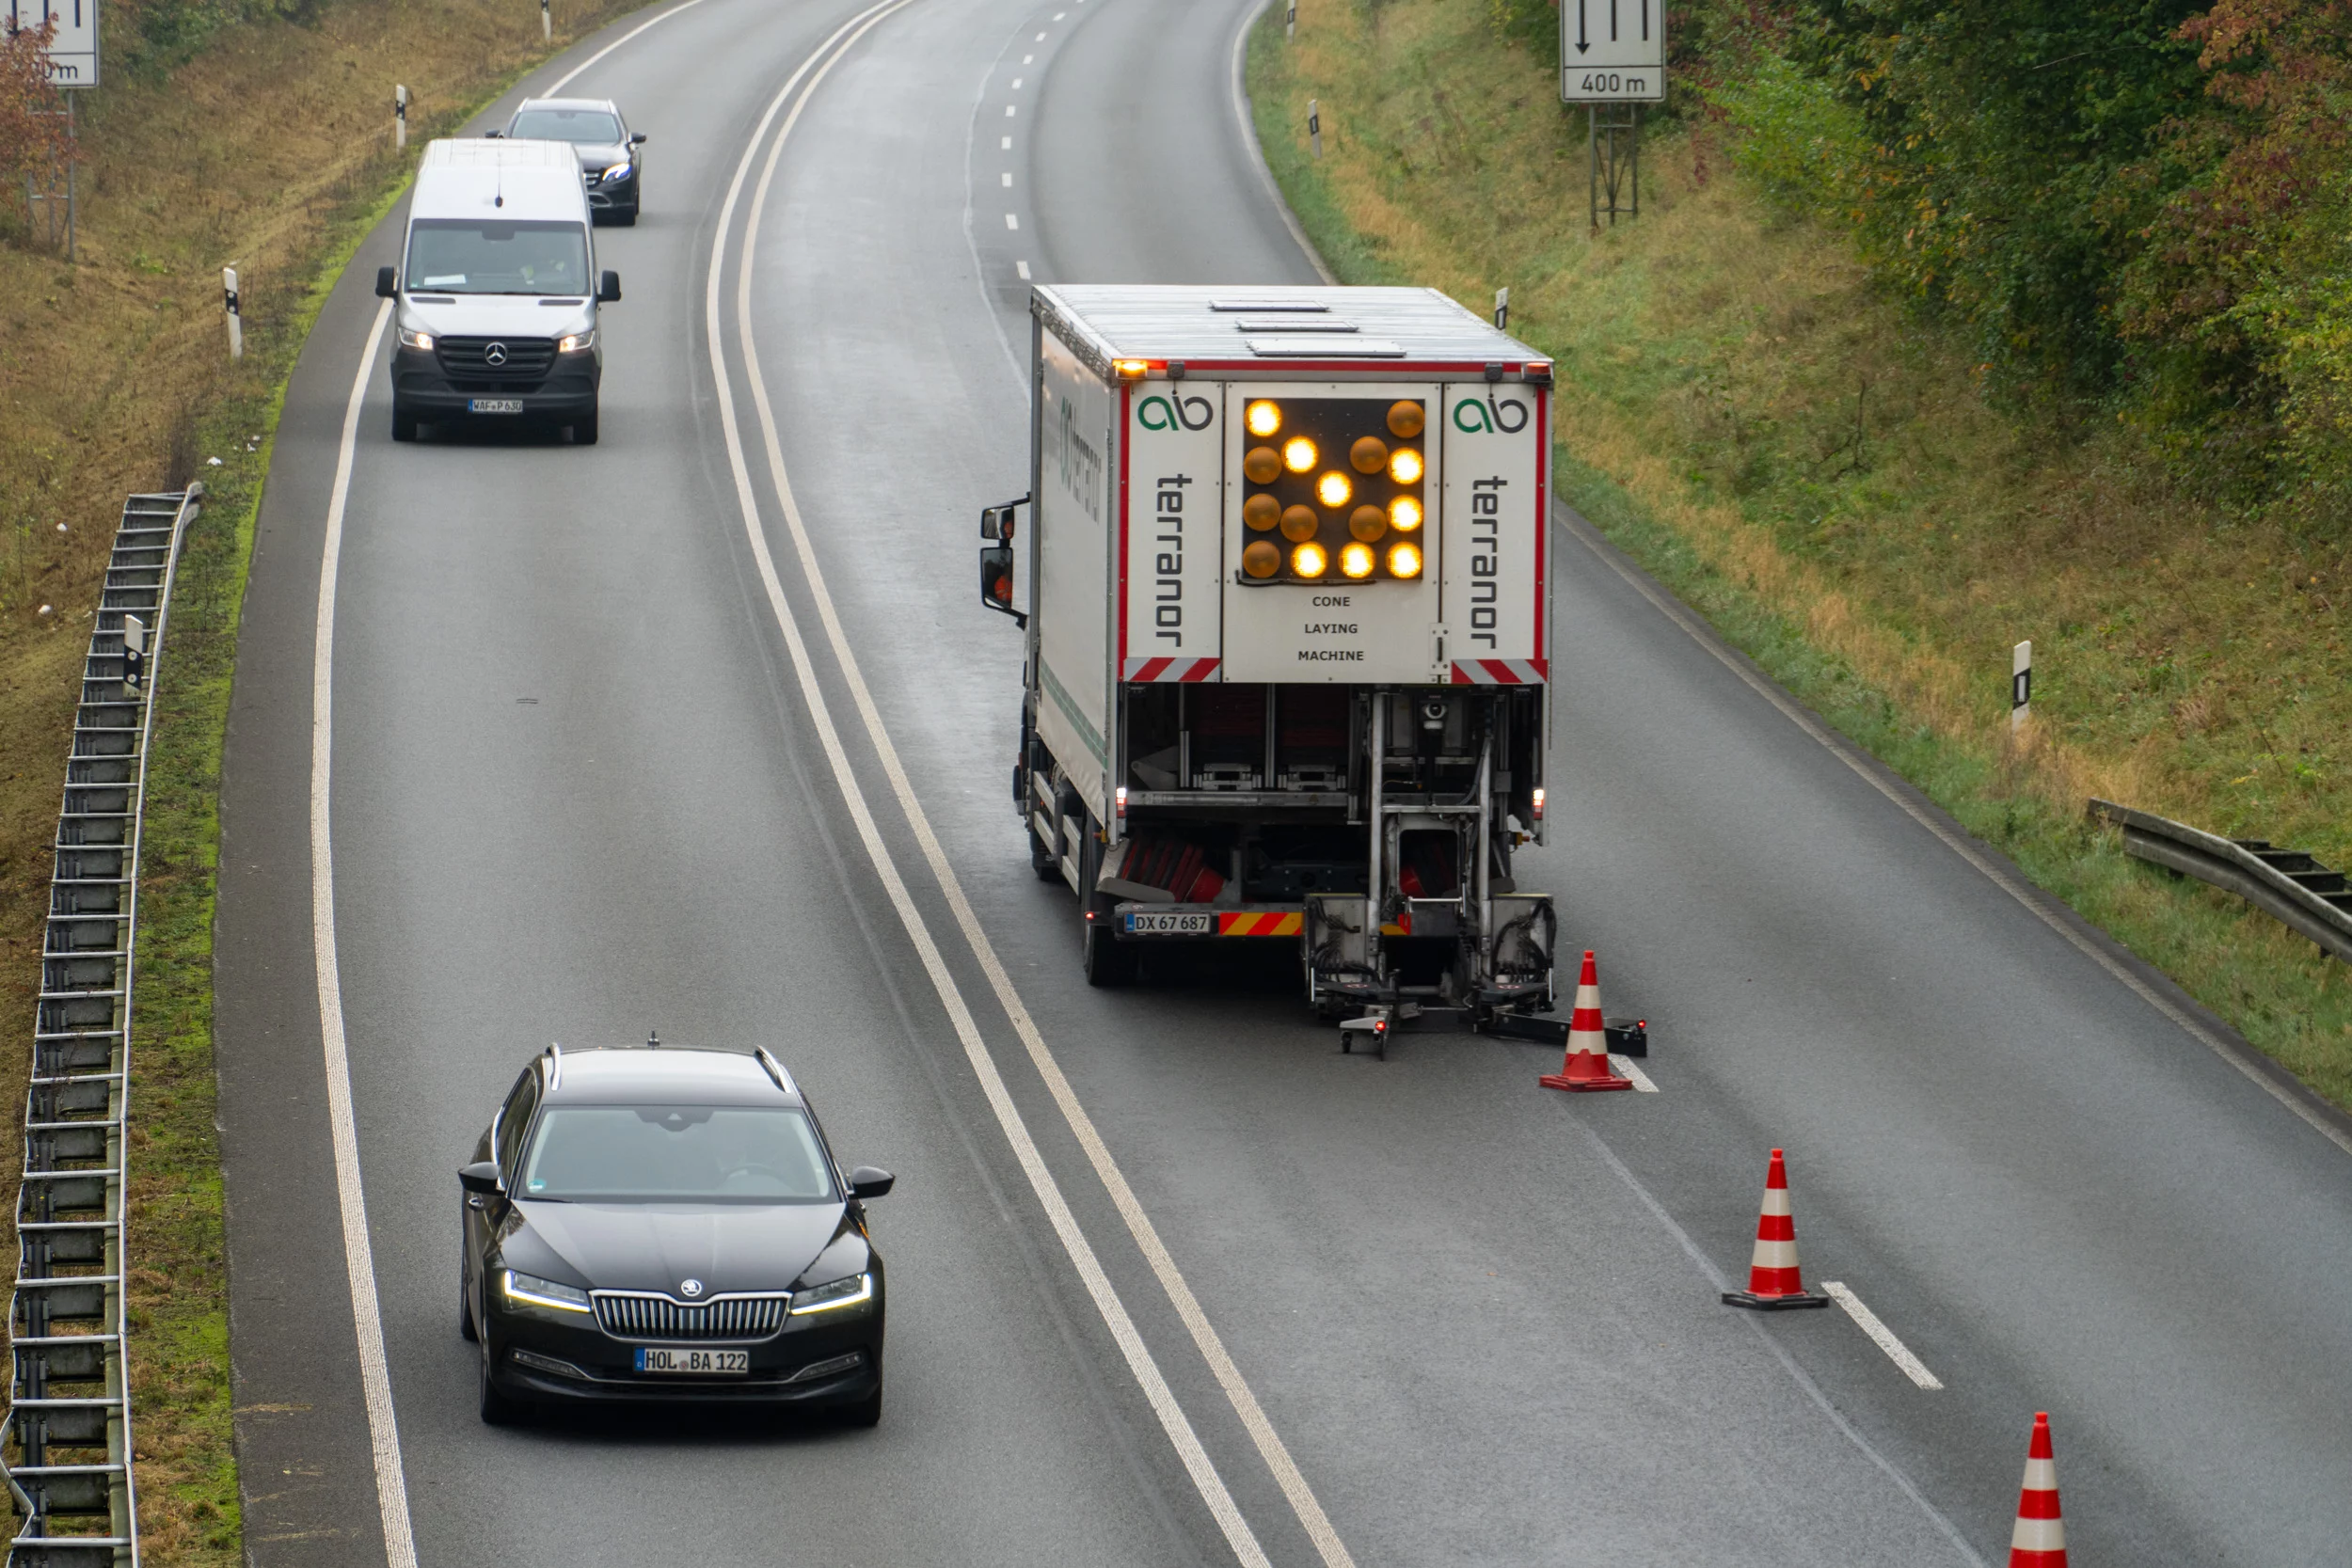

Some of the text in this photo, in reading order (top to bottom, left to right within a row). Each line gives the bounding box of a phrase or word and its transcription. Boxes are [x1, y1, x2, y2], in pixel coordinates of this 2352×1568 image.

[58, 65, 79, 79] m
[1581, 73, 1645, 92] 400 m
[1137, 395, 1214, 431] ab
[1453, 398, 1529, 434] ab
[1155, 473, 1193, 647] terranor
[1470, 475, 1508, 649] terranor
[1312, 595, 1351, 607] CONE
[1304, 623, 1359, 634] LAYING
[1297, 650, 1364, 661] MACHINE
[1136, 916, 1207, 930] DX 67 687
[645, 1351, 747, 1371] HOL BA 122
